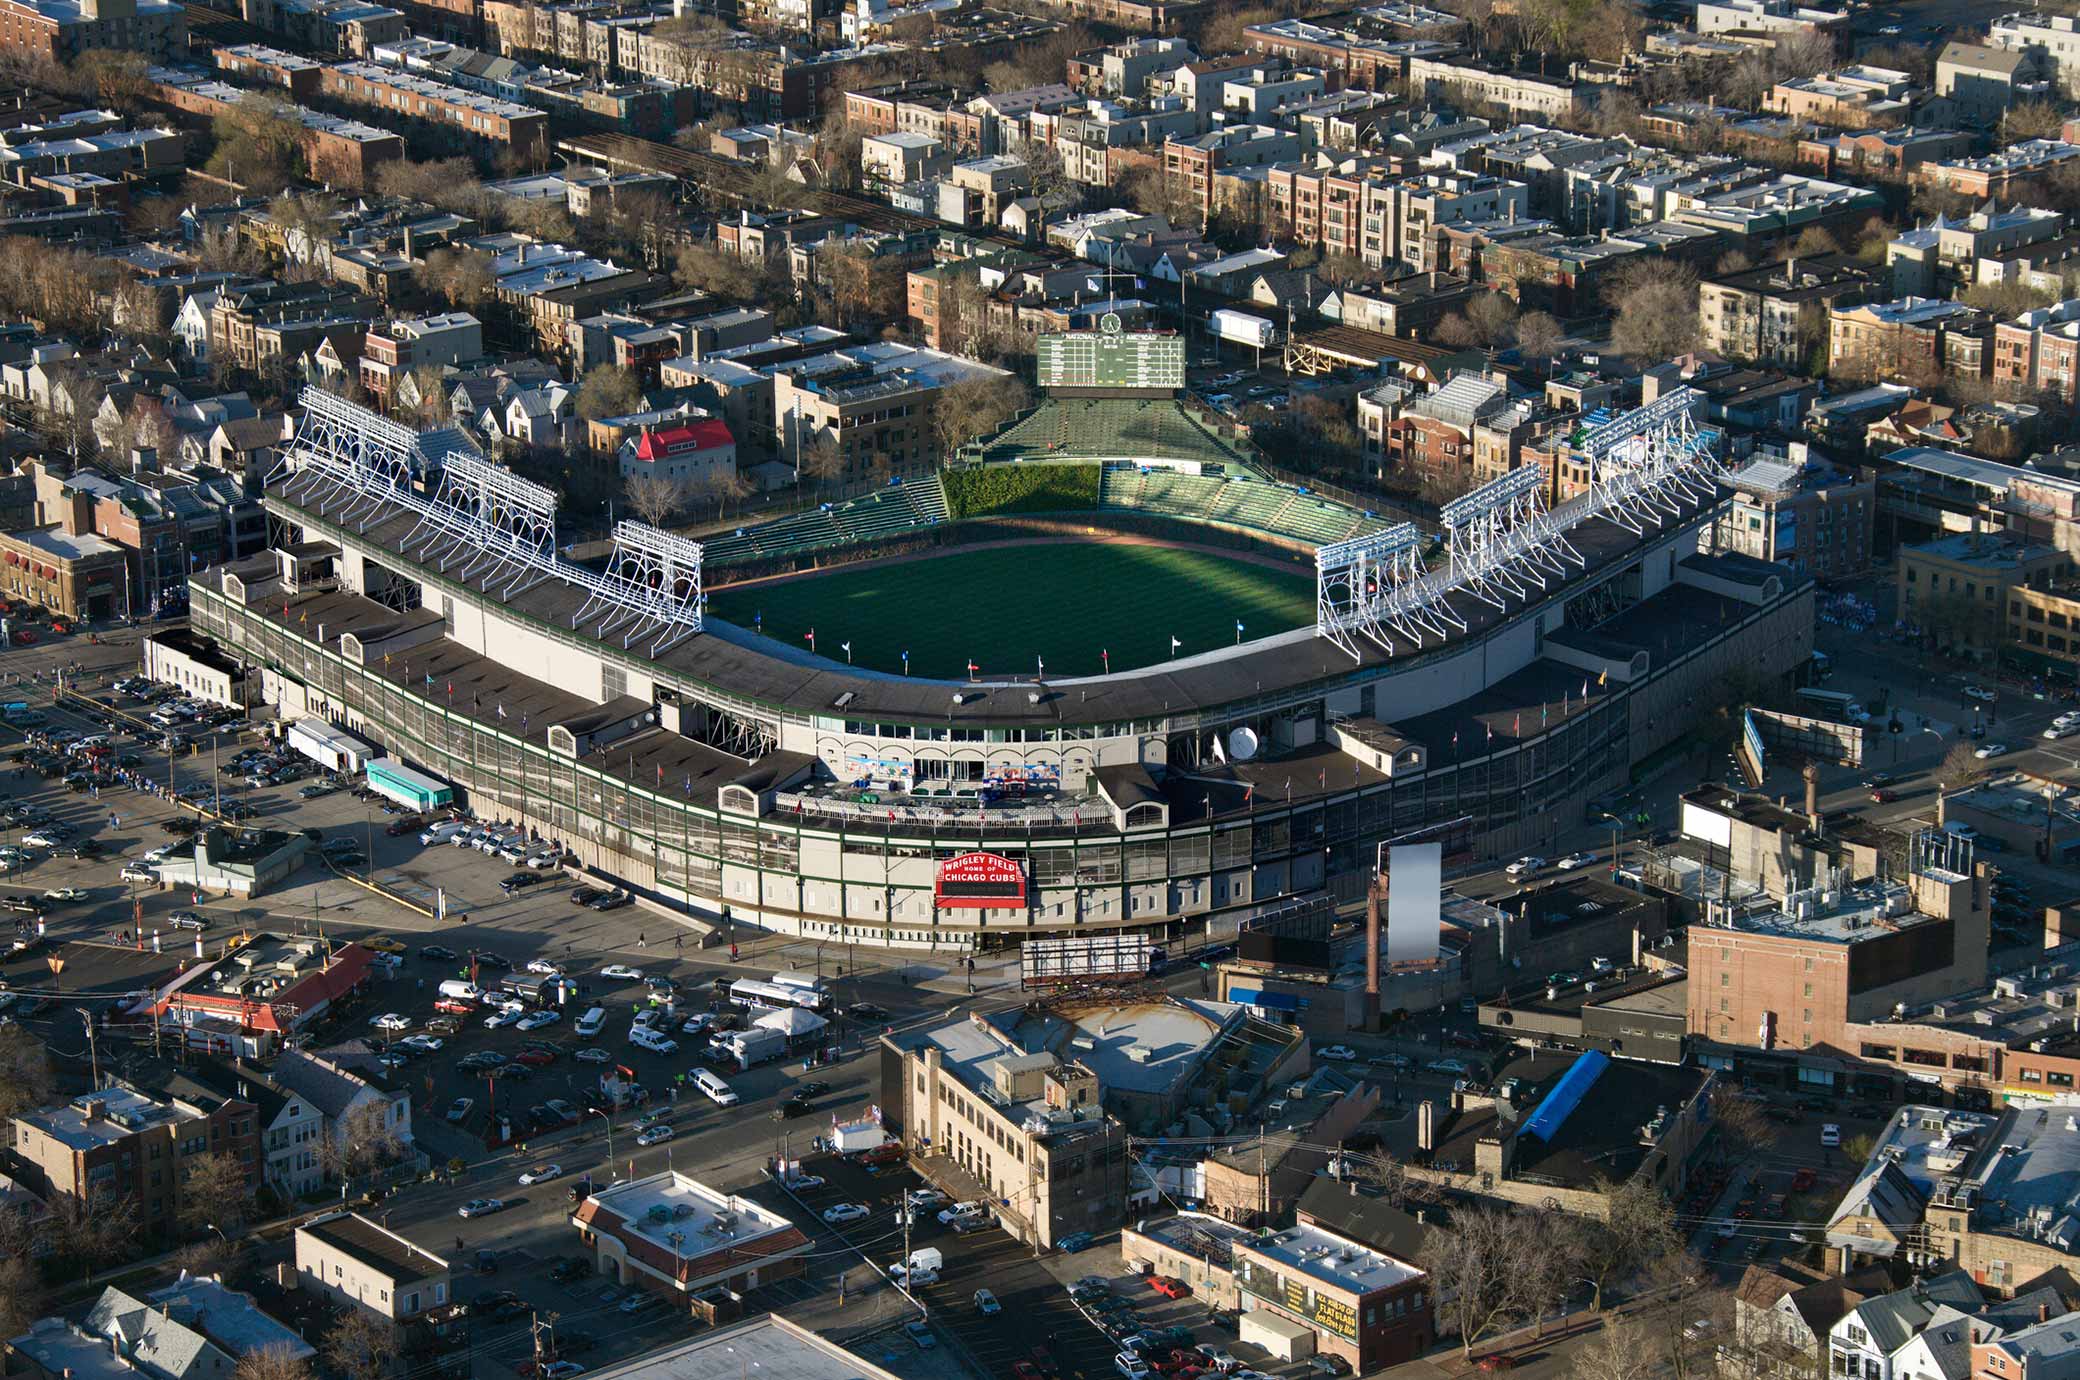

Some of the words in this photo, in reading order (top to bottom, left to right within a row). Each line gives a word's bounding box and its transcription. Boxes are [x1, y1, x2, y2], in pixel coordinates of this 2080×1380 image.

[945, 855, 985, 871] WRIGLEY
[988, 857, 1015, 871] FIELD
[990, 874, 1016, 882] CUBS
[1316, 1294, 1326, 1303] ALL
[1345, 1307, 1355, 1316] OF
[1320, 1303, 1335, 1318] FLAT
[1335, 1311, 1356, 1327] GLASS
